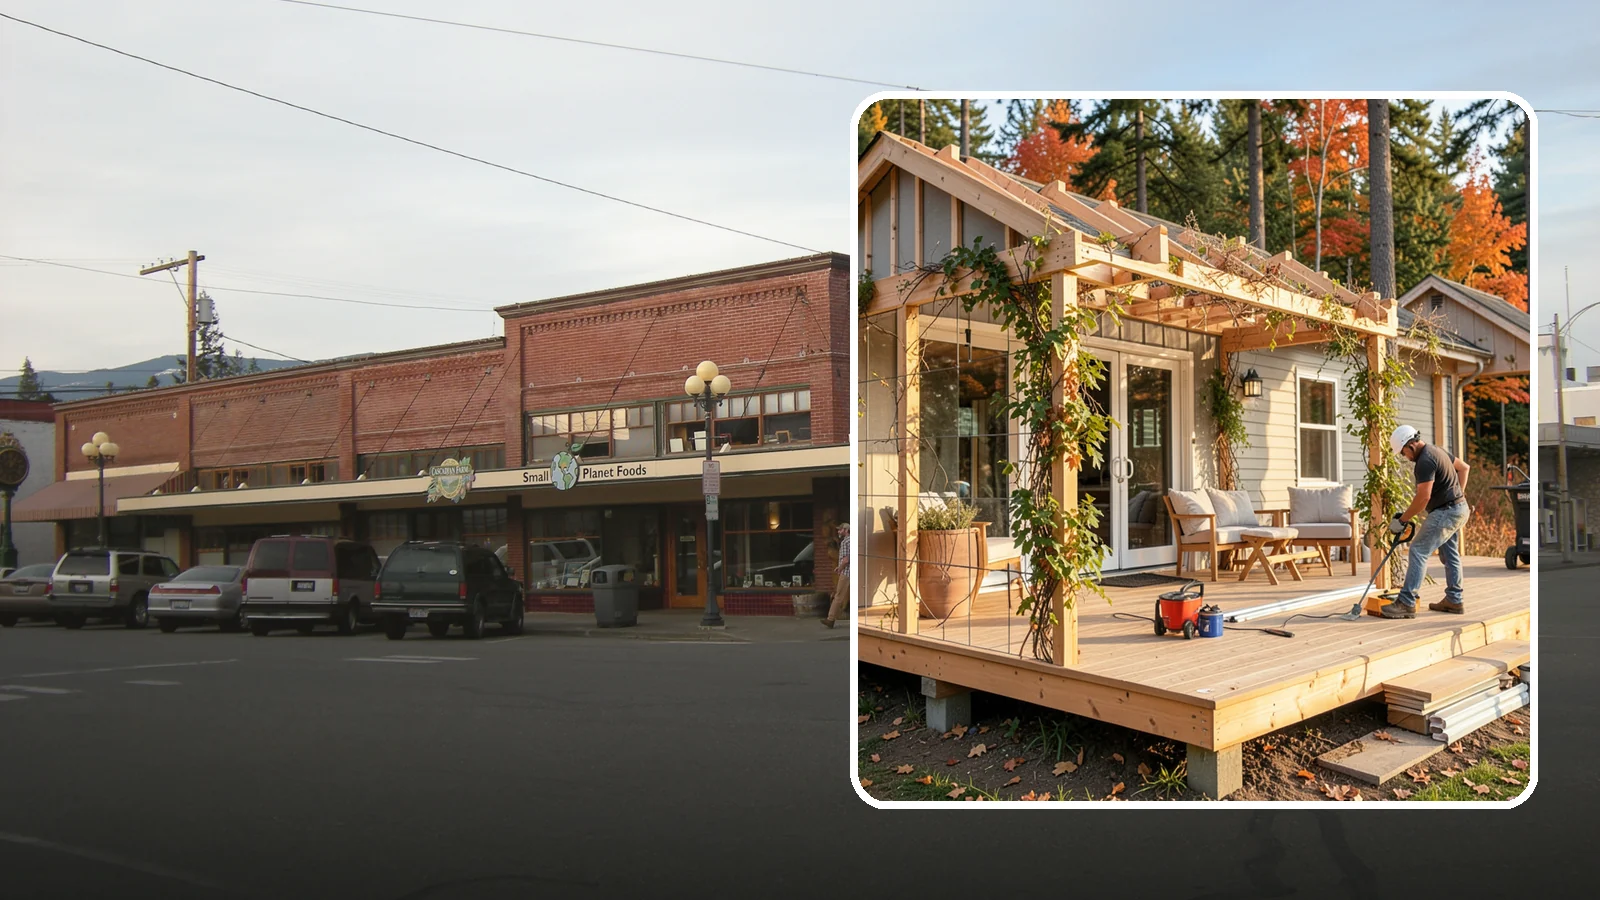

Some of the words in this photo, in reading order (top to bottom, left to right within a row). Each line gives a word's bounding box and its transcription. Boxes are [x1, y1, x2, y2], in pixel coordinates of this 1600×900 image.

[522, 471, 549, 483] Small
[582, 466, 614, 479] Planet
[616, 464, 647, 477] Foods
